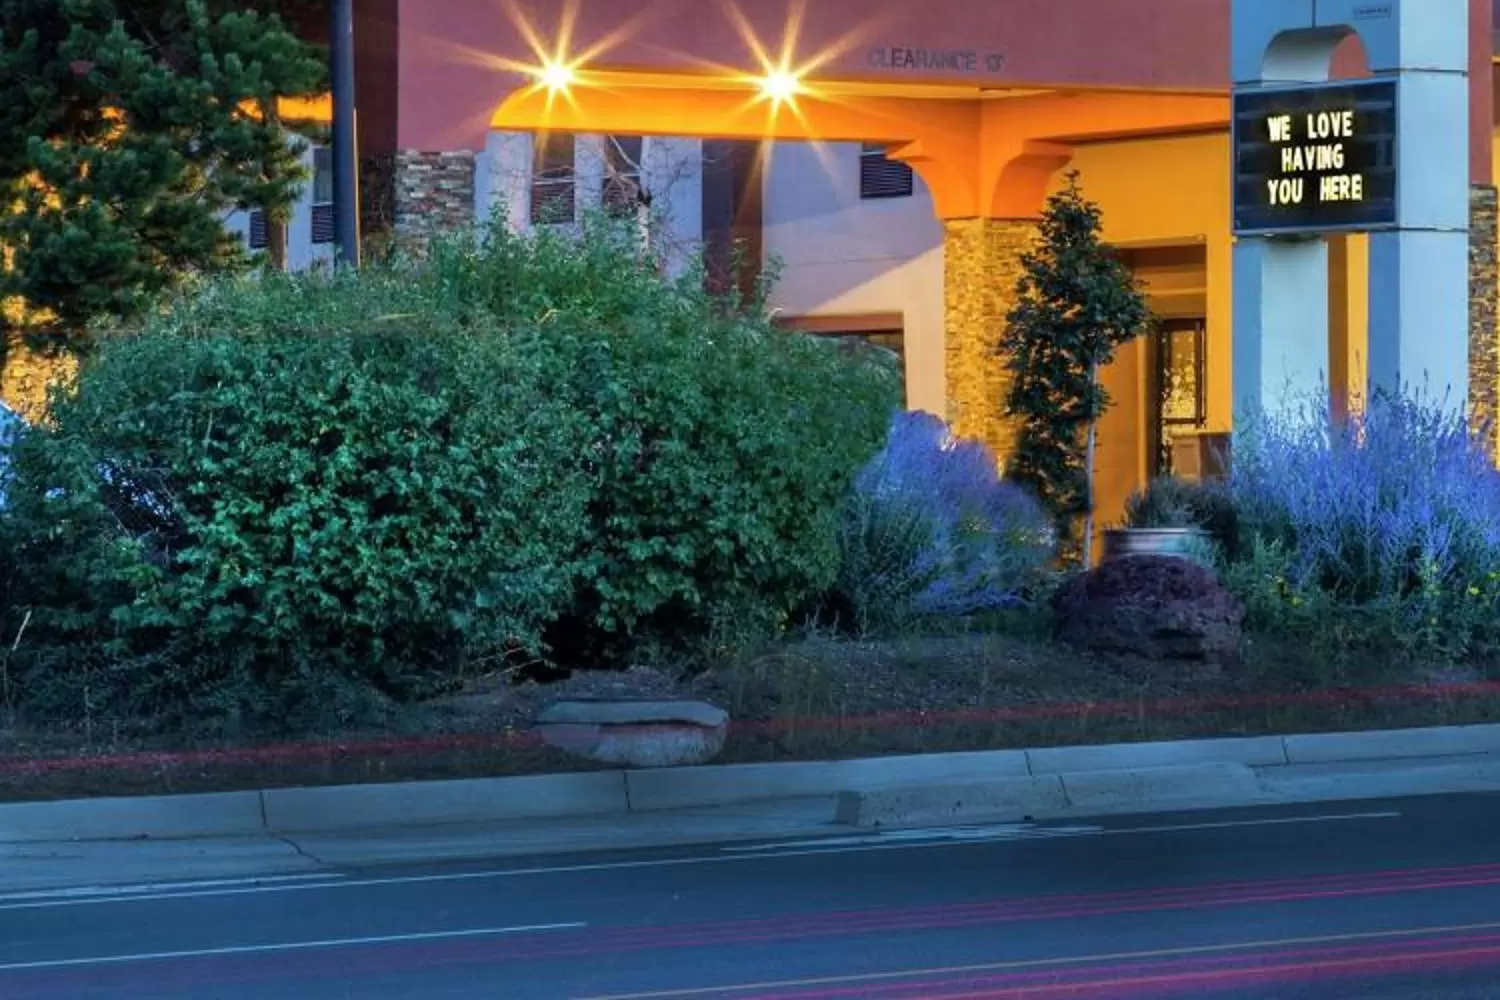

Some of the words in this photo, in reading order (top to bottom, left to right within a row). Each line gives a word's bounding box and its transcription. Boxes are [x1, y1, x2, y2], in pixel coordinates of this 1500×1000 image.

[1267, 115, 1292, 142] WE
[1307, 111, 1353, 139] LOVE
[1281, 143, 1345, 172] HAVING
[1267, 177, 1304, 205] YOU
[1319, 173, 1363, 202] HERE
